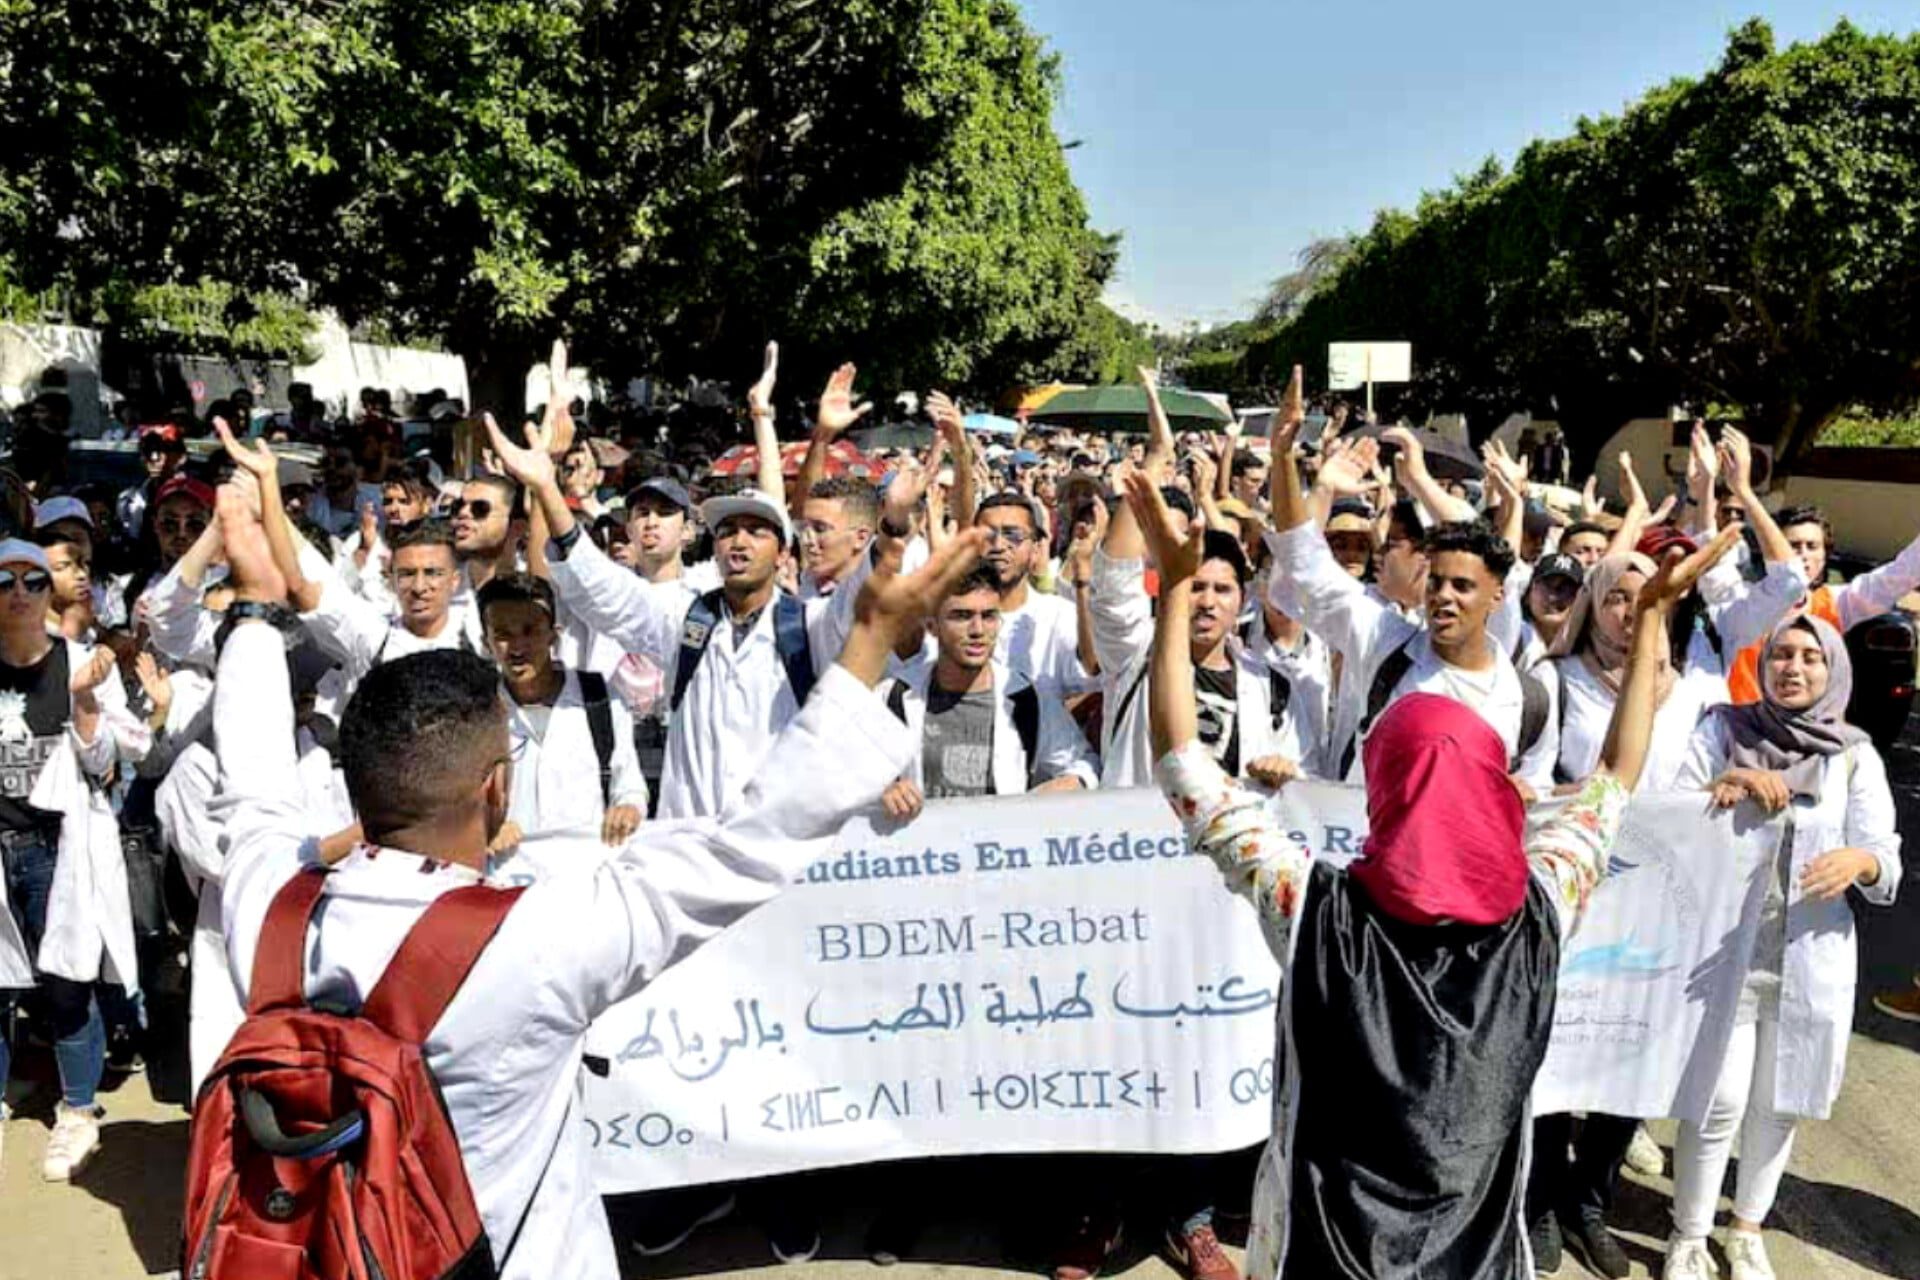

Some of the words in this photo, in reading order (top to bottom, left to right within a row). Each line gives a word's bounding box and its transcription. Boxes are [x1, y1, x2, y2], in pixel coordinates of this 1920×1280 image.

[794, 848, 961, 885] udiants
[974, 841, 1032, 872] En
[1044, 831, 1194, 866] Médeci
[817, 906, 1149, 962] BDEM-Rabat
[805, 982, 965, 1043] الطب
[981, 971, 1094, 1034] طلبة
[1112, 970, 1278, 1028] كتب
[615, 998, 788, 1082] بالرباط
